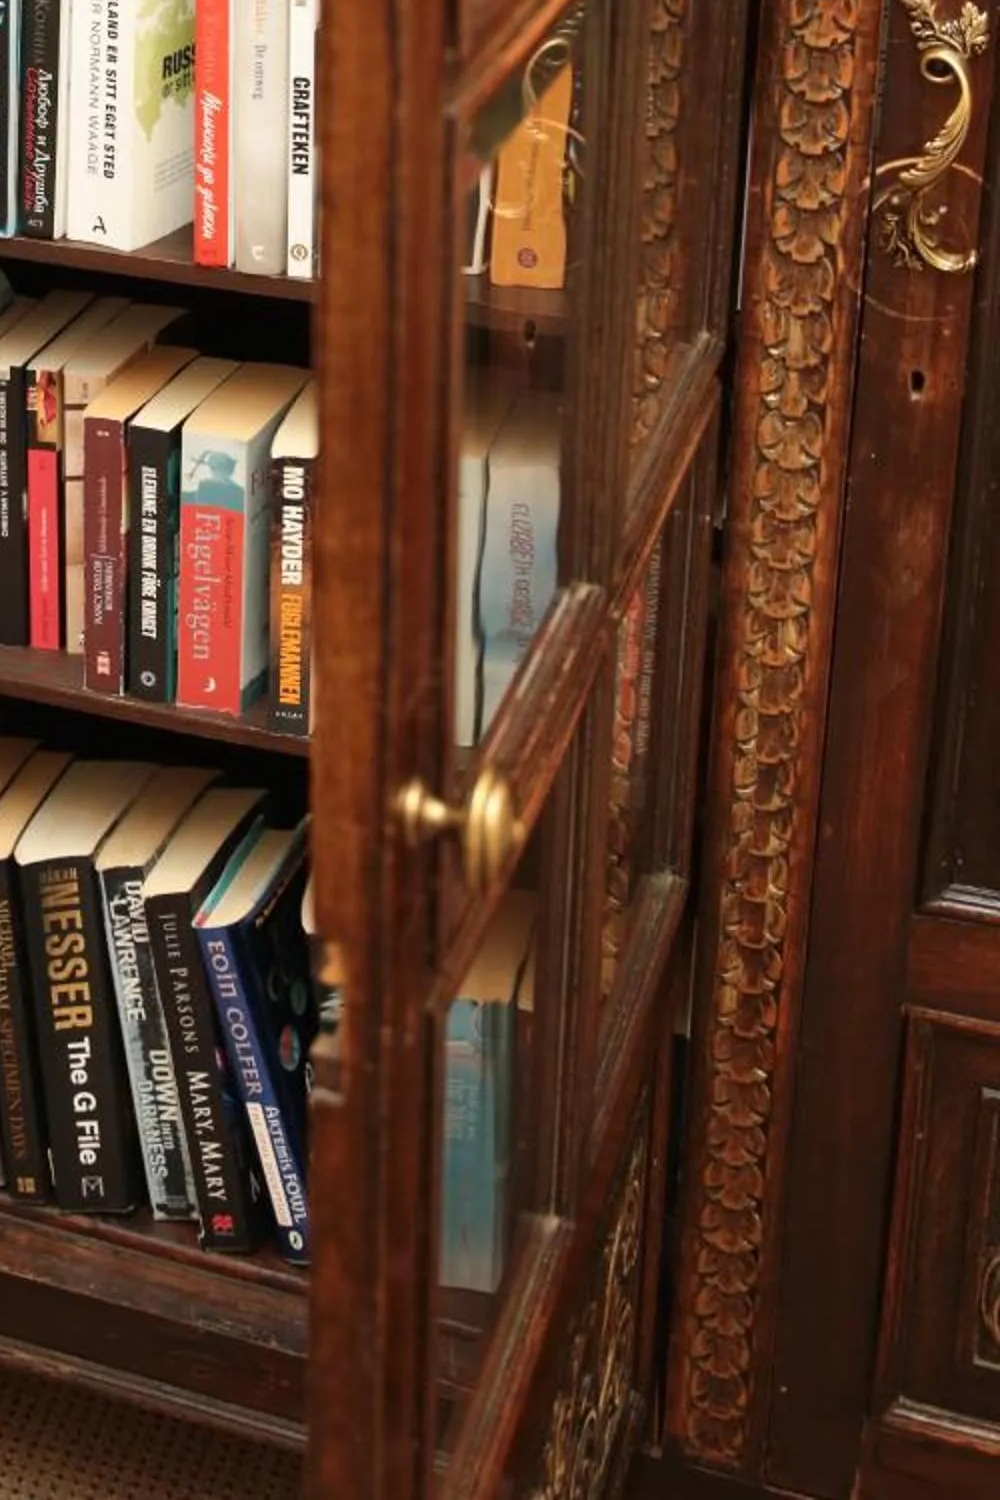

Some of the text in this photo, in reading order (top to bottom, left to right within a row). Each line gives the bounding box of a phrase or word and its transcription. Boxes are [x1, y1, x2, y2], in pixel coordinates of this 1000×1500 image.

[88, 20, 101, 111] NORMANN
[105, 66, 117, 101] SITT
[107, 44, 119, 61] ER
[253, 44, 267, 60] De
[86, 113, 98, 176] WAAGE
[102, 140, 115, 180] STED
[103, 104, 117, 136] EGET
[291, 75, 310, 176] GRAFTEKEN
[140, 518, 157, 535] EN
[140, 535, 157, 570] DRINK
[281, 466, 305, 587] MO HAYDER
[186, 512, 220, 661] Fågelvägen
[279, 593, 301, 705] FUGLEMANNEN
[122, 880, 149, 944] DAVID
[38, 880, 95, 1033] NESSER
[106, 894, 147, 1023] LAWRENCE
[157, 912, 199, 1054] JULIE PARSONS
[148, 1048, 179, 1124] DOWN
[225, 1007, 264, 1098] COLFER
[10, 1116, 27, 1160] DAYS
[66, 1036, 101, 1166] The G File
[135, 1079, 169, 1179] DARKNESS
[186, 1071, 228, 1202] MARY, MARY
[283, 1169, 308, 1224] FOWL
